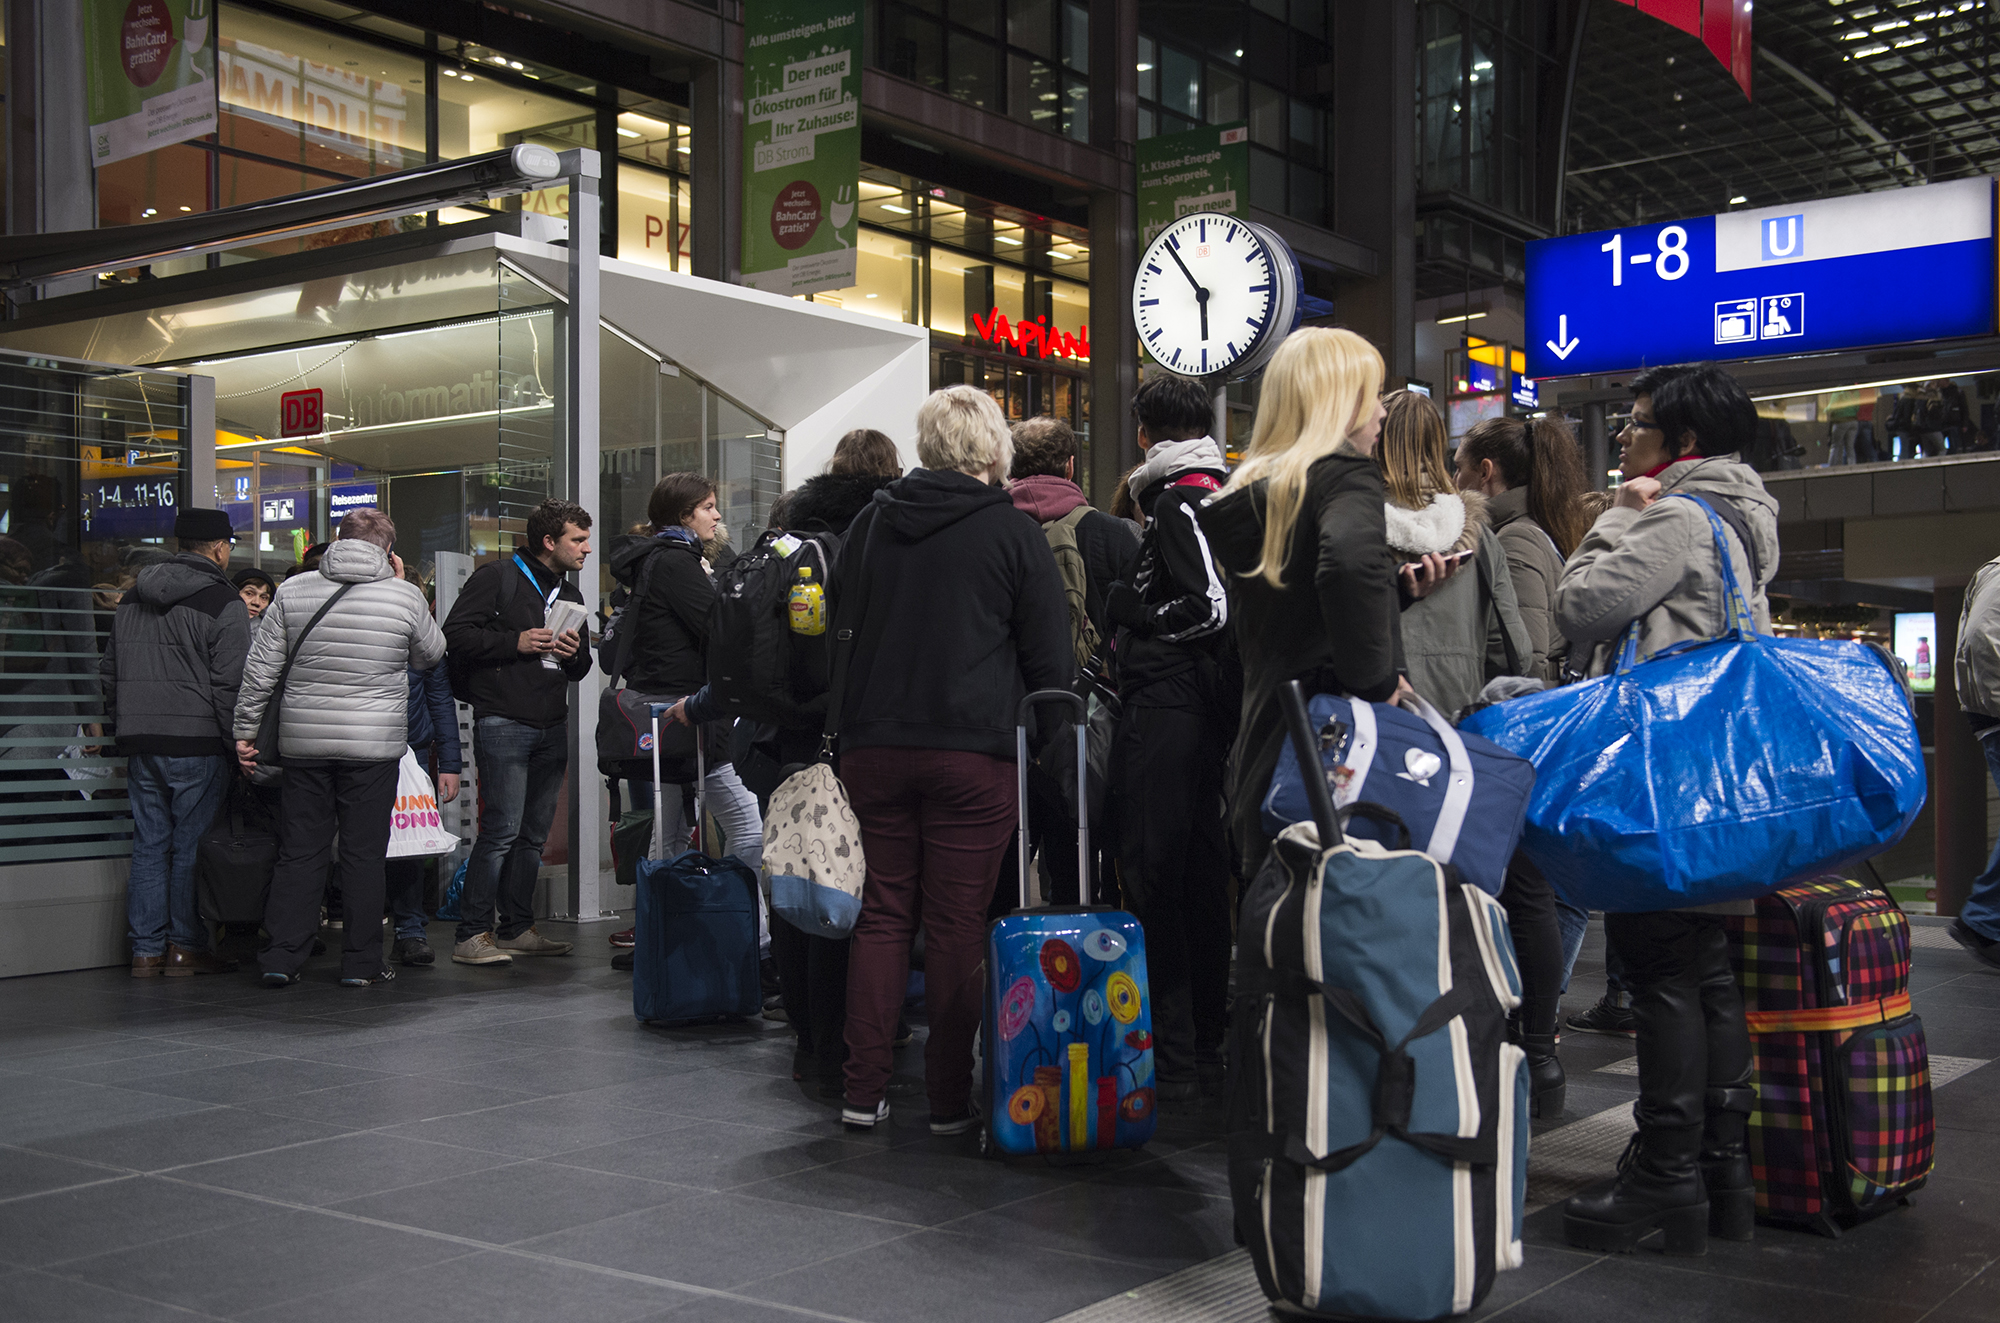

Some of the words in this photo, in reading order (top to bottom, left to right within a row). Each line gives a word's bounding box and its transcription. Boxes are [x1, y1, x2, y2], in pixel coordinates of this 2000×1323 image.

[138, 4, 153, 17] Jetzt
[131, 16, 161, 29] wechseln:
[749, 35, 768, 48] Alle
[770, 23, 826, 43] umsteigen,
[827, 12, 856, 29] bitte!
[125, 31, 167, 49] BahnCard
[788, 68, 811, 84] Der
[814, 60, 845, 78] neue
[753, 94, 816, 117] Ökostrom
[819, 86, 837, 103] für
[182, 112, 212, 126] DBStrom.de
[776, 122, 794, 137] Ihr
[797, 110, 854, 133] Zuhause:
[757, 149, 774, 166] DB
[776, 145, 811, 162] Strom.
[1141, 163, 1149, 173] 1.
[1151, 150, 1221, 171] Klasse-Energie
[1142, 177, 1162, 188] zum
[1163, 168, 1211, 186] Sparpreis.
[791, 190, 806, 199] Jetzt
[776, 210, 817, 221] BahnCard
[1179, 203, 1200, 215] Der
[1203, 198, 1231, 211] neue
[1769, 218, 1796, 256] U
[1198, 248, 1208, 256] DB
[1601, 226, 1690, 286] 1-8
[973, 306, 1090, 359] VAPiAN
[286, 396, 319, 431] DB
[134, 482, 174, 507] 11-16
